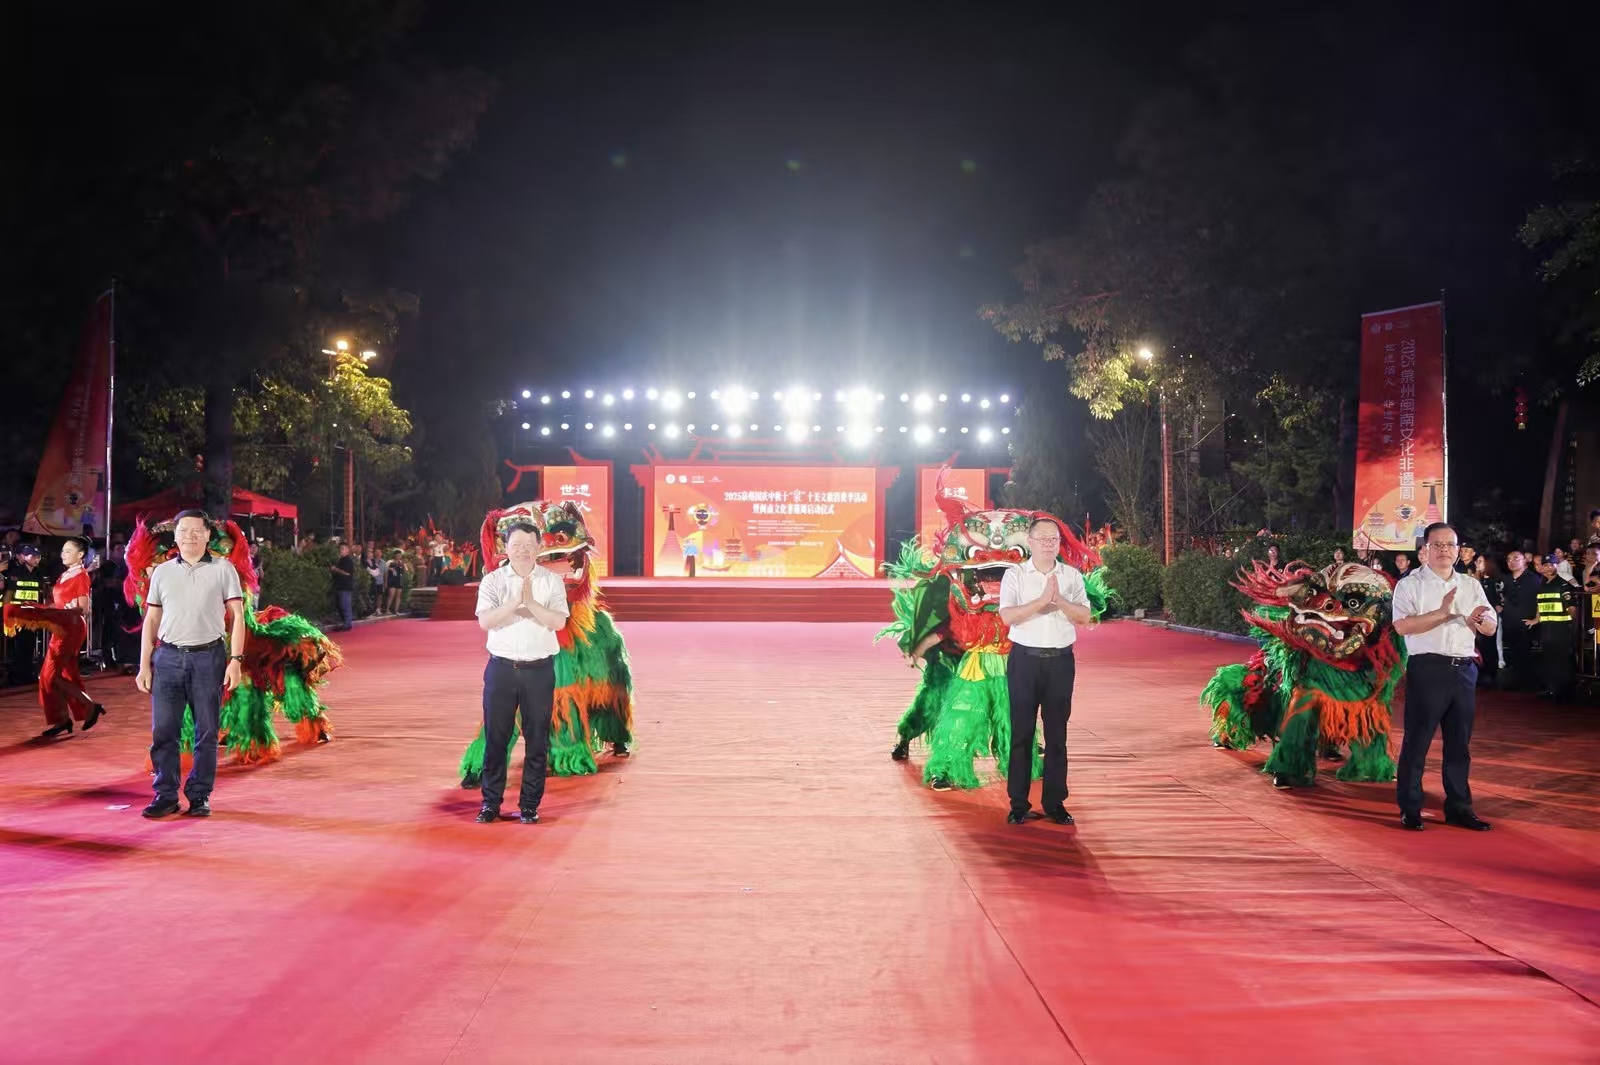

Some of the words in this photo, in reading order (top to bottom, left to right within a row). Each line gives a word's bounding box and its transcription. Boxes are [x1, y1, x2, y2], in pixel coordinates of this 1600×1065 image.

[1399, 338, 1416, 501] 2025泉州闽南文化非遗周
[559, 484, 592, 497] 世遗
